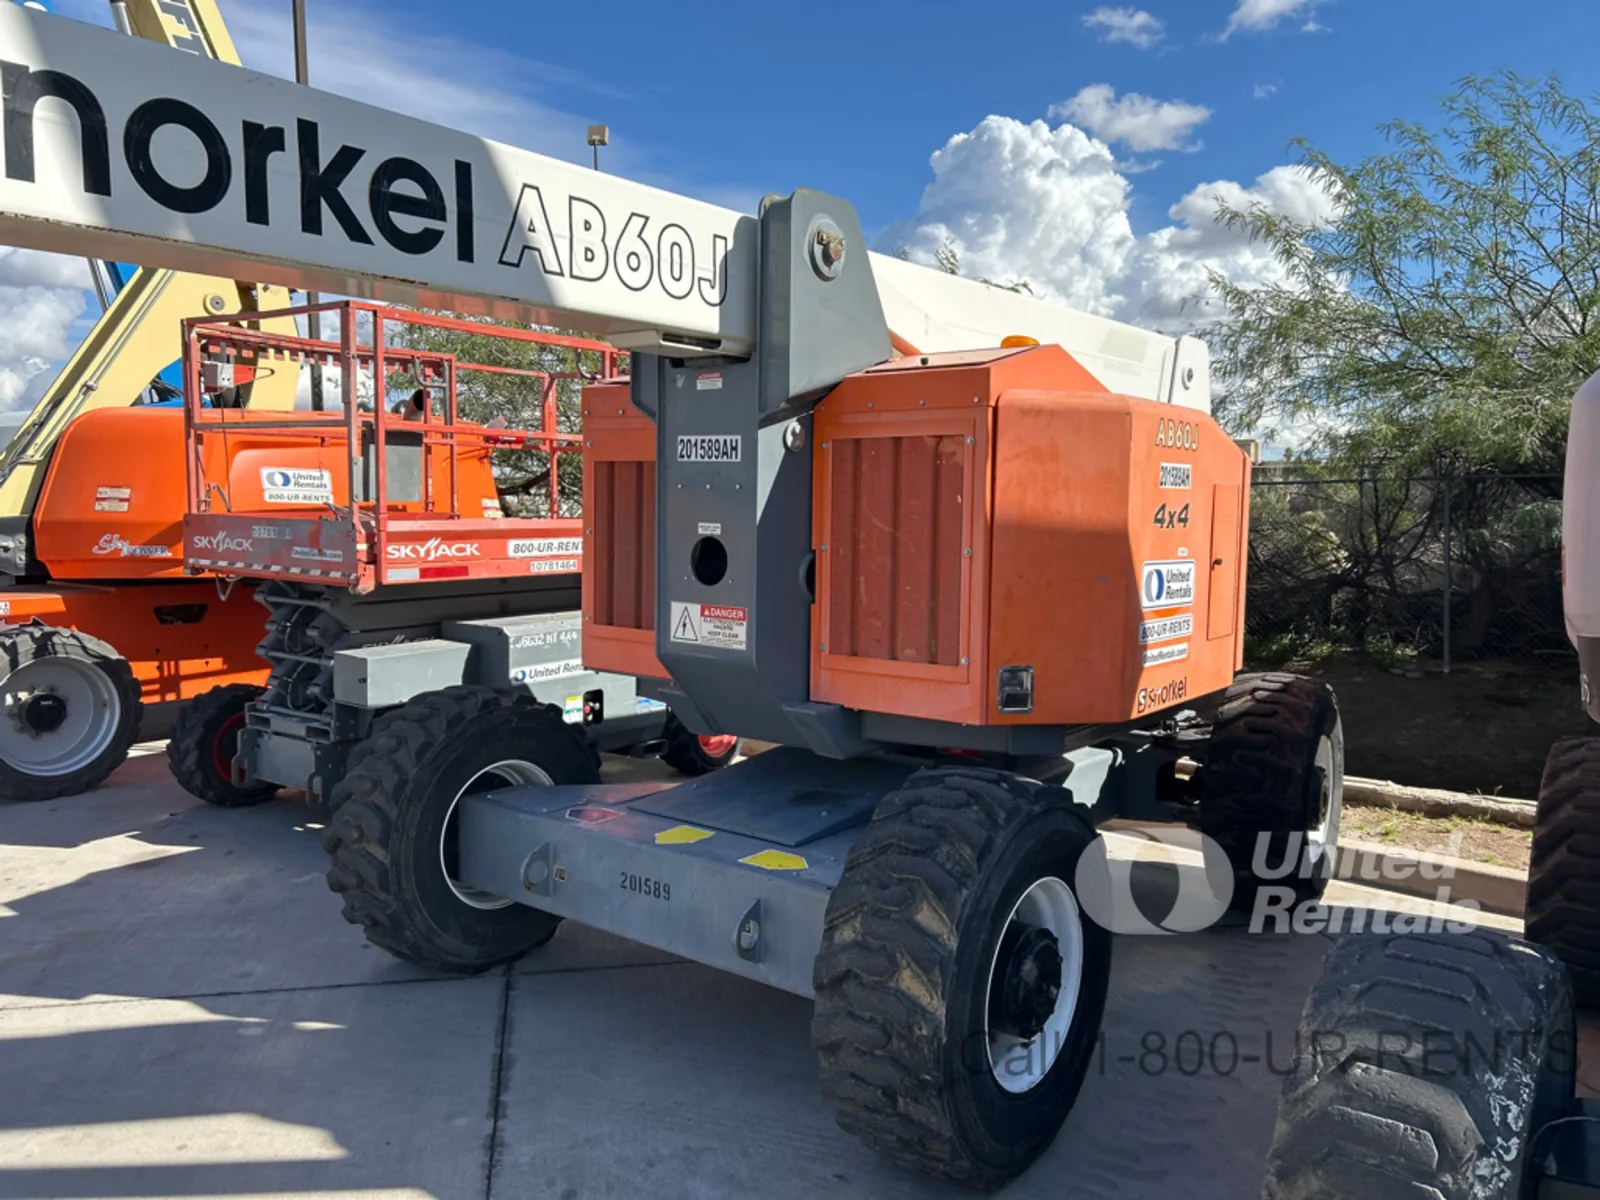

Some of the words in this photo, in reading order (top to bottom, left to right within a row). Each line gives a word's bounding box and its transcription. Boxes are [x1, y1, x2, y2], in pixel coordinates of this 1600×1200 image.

[498, 182, 728, 308] AB60J
[1155, 417, 1199, 452] AB60J
[678, 437, 740, 460] 201589AH
[292, 472, 325, 481] United
[293, 480, 328, 489] Rentals
[268, 493, 331, 502] 800-UR-RENTS
[1153, 503, 1190, 529] 4x4
[193, 530, 254, 553] SKYJACK
[386, 537, 481, 561] SKYJACK
[531, 560, 577, 572] 10781464
[1165, 568, 1191, 583] United
[1165, 586, 1192, 600] Rentals
[710, 607, 744, 619] DANGER
[1141, 619, 1192, 640] 800-UR-RENTS
[528, 665, 562, 680] United
[620, 871, 671, 901] 201589
